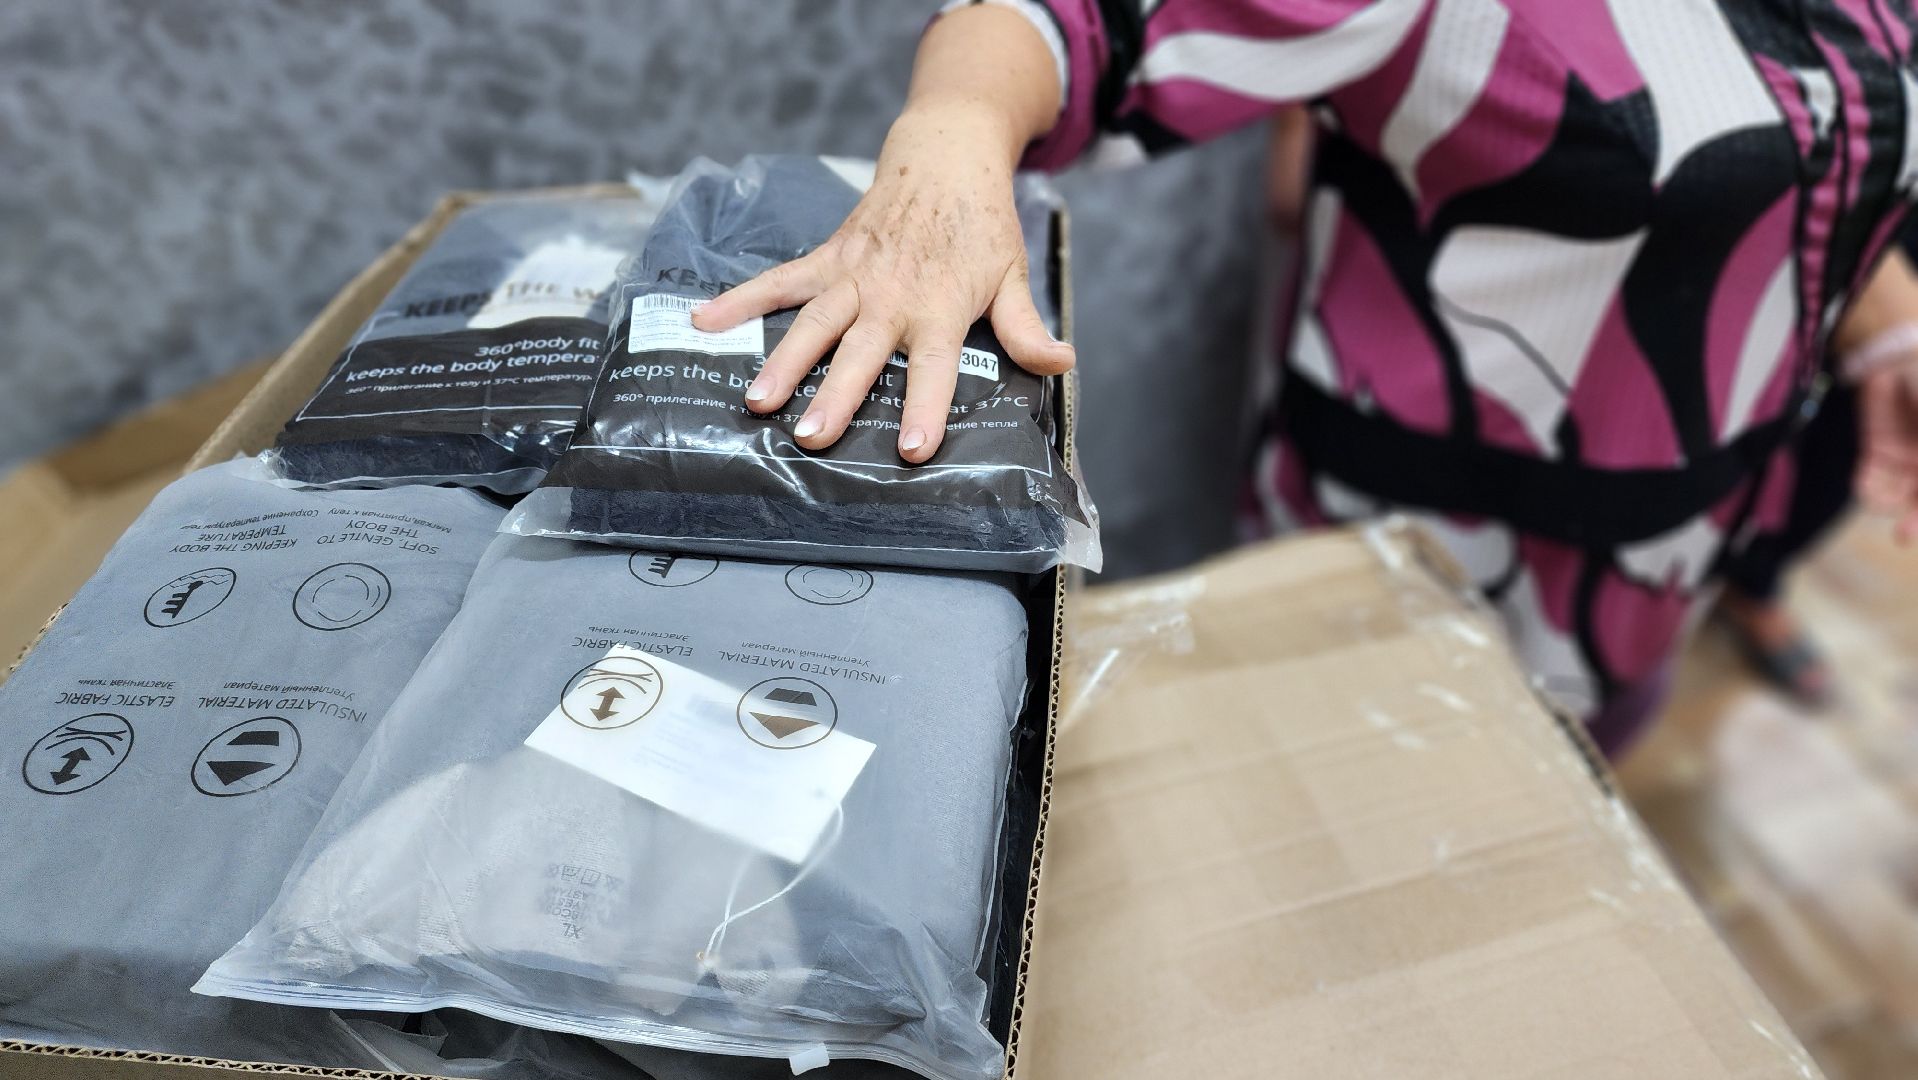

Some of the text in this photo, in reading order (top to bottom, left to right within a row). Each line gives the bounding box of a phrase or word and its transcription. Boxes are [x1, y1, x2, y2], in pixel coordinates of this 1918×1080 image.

[578, 337, 600, 350] fit
[345, 352, 600, 383] keeps the body tempera
[962, 352, 997, 373] 3047
[456, 380, 480, 388] телу
[608, 363, 676, 383] keeps
[683, 361, 722, 383] the
[729, 373, 753, 390] bo
[974, 396, 1029, 411] 37°C
[612, 393, 644, 403] 360°
[645, 394, 727, 410] прилегание
[729, 403, 737, 412] к
[850, 419, 900, 431] ература
[981, 420, 1018, 429] тепла
[263, 508, 319, 521] Сохранение
[328, 507, 351, 516] телу
[203, 516, 261, 530] температуры
[345, 519, 419, 539] THE BODY
[195, 524, 287, 541] TEMPERATURE
[169, 539, 298, 553] KEEPING THE BODY
[316, 532, 440, 555] SOFT, GENTLE TO
[588, 626, 621, 635] ткань
[572, 636, 694, 657] ELASTIC FABRIC
[741, 641, 797, 655] материал
[718, 650, 887, 685] INSULATED MATERIAL
[78, 679, 176, 690] Эластичная ткань
[223, 681, 280, 694] материал
[55, 692, 176, 708] ELASTIC FABRIC
[198, 696, 368, 724] INSULATED MATERIAL
[561, 922, 584, 939] XL
